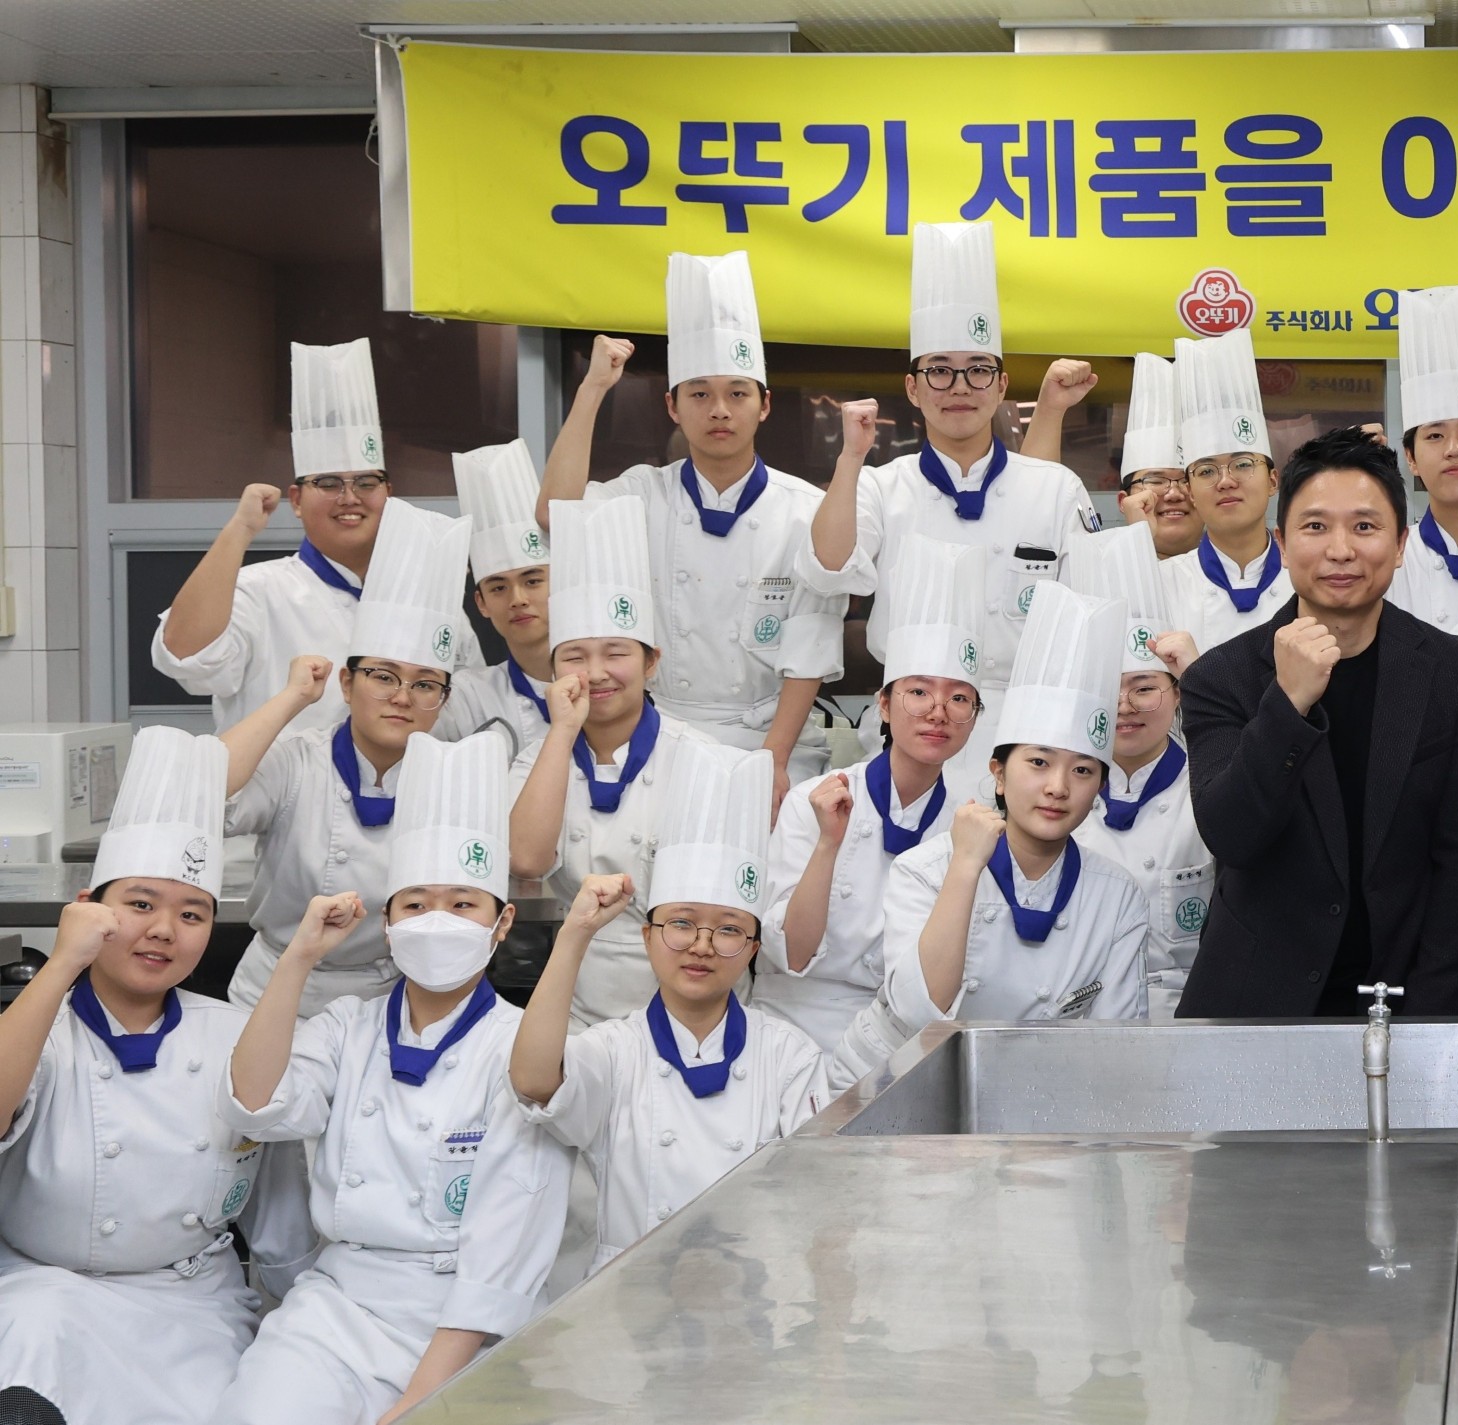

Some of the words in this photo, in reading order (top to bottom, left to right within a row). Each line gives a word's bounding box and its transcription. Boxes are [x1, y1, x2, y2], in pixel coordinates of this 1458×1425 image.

[551, 115, 909, 236] 오뚜기
[959, 113, 1332, 238] 제품을
[1195, 307, 1239, 324] 오뚜기
[1265, 310, 1353, 332] 주식회사
